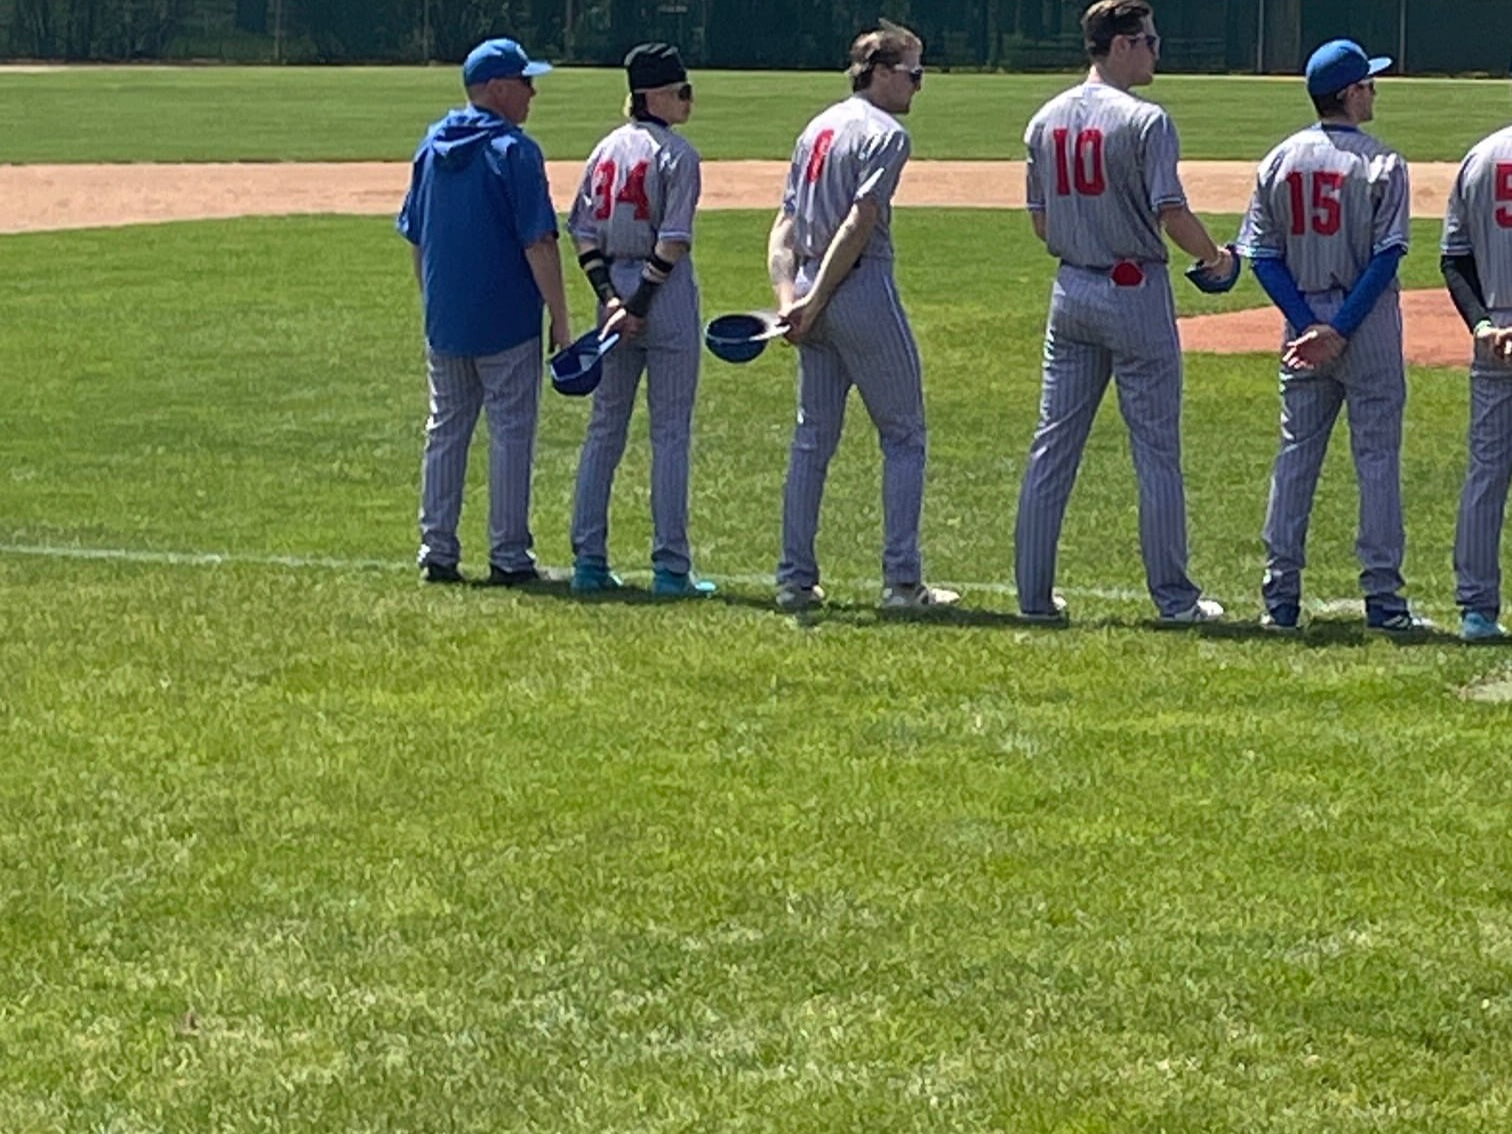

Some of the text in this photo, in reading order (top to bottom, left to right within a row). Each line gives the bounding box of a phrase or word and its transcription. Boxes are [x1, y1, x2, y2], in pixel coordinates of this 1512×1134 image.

[595, 160, 651, 220] 34
[1053, 128, 1105, 195] 10
[1286, 171, 1346, 236] 15
